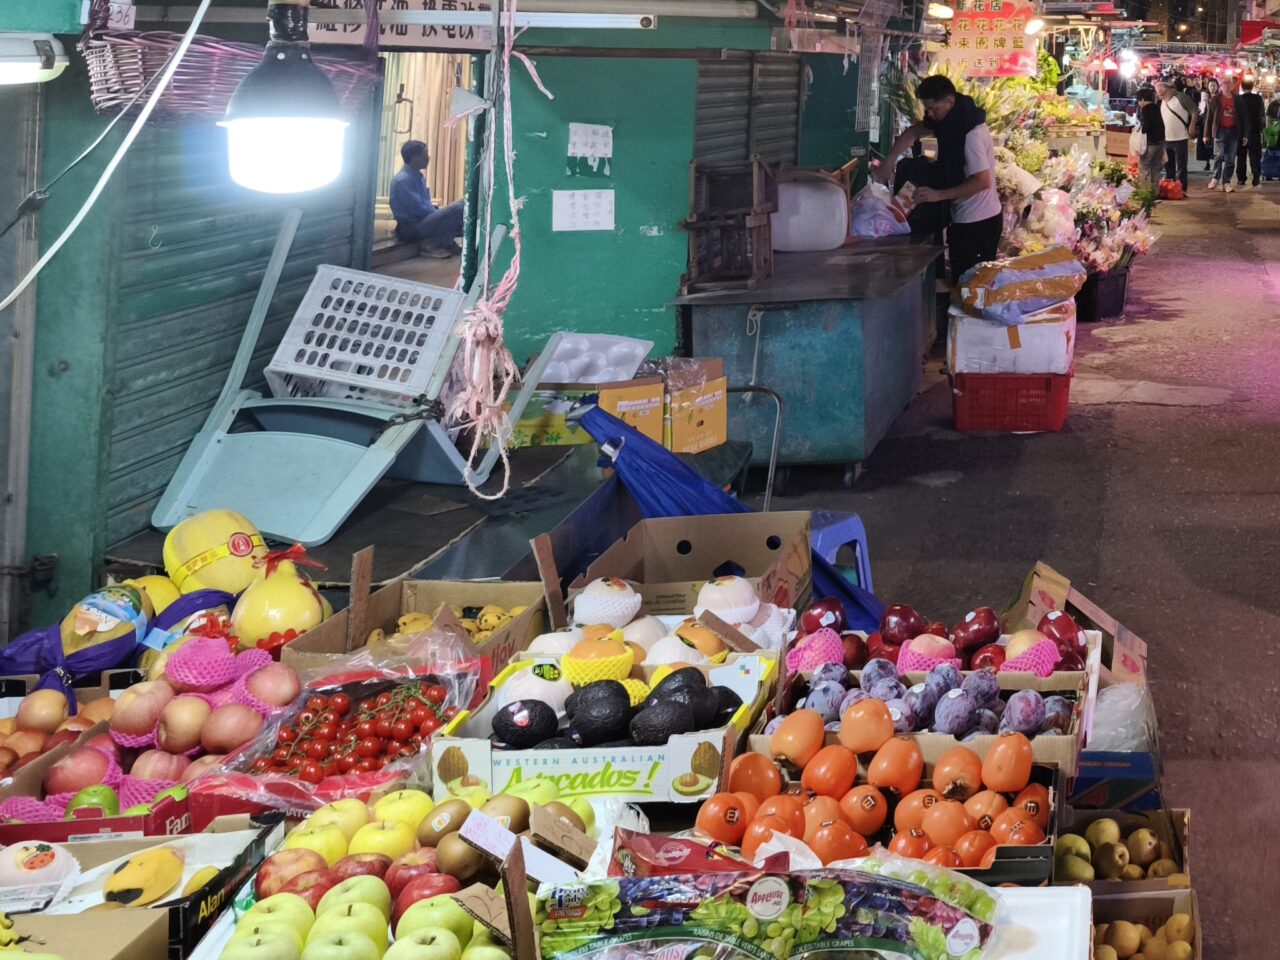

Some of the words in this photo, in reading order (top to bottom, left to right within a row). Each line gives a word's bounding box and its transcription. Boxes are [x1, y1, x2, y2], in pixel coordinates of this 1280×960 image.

[493, 758, 560, 767] WESTERN
[571, 753, 666, 765] AUSTRALIAN
[751, 890, 783, 905] APPLAUSE
